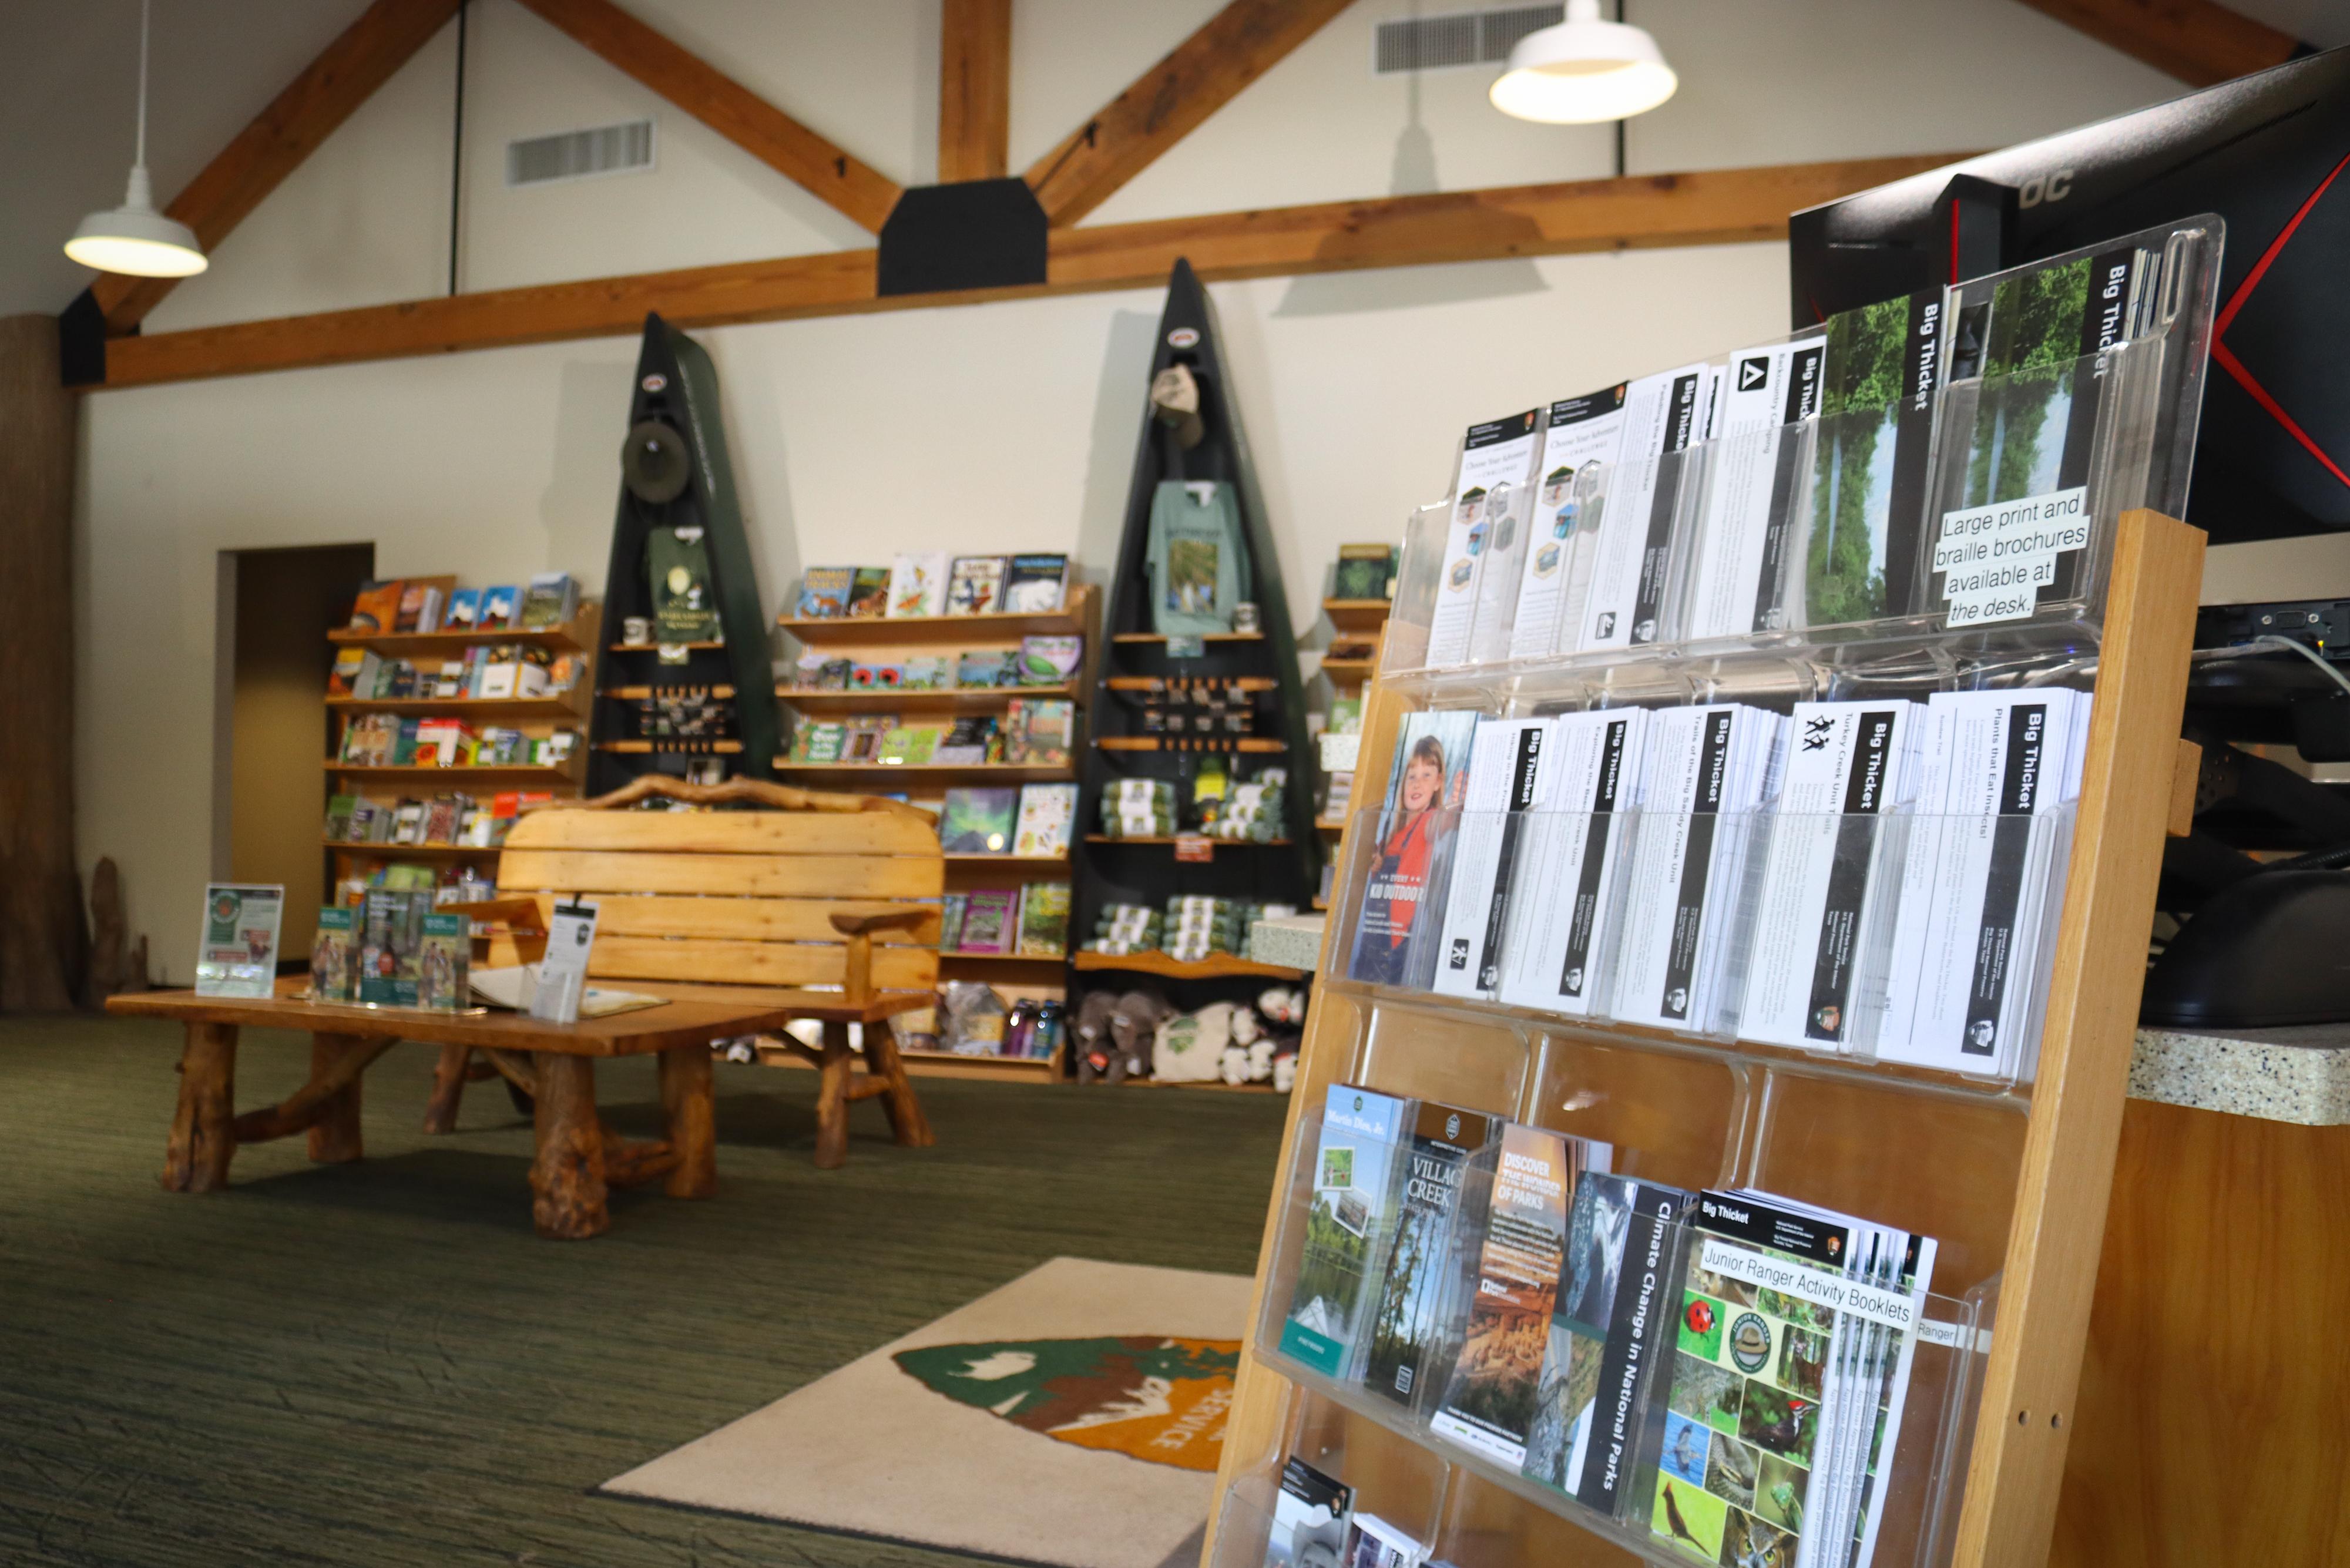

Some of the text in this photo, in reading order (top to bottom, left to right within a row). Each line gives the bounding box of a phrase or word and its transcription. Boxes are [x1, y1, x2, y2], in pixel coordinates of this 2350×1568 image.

[2019, 170, 2074, 209] OC
[2103, 264, 2126, 298] Big
[1801, 356, 1818, 381] Big
[1915, 303, 1938, 411] Big Thicket
[1673, 379, 1696, 455] Big Thicke
[1943, 493, 2080, 538] Large print and
[1936, 526, 2086, 566] braille brochures
[1948, 561, 2052, 593] available at
[1951, 594, 2031, 621] the desk.
[1837, 711, 1853, 747] Turkey
[1506, 733, 1518, 760] Hiking
[1587, 726, 1602, 770] Exploring
[1519, 730, 1542, 804] Big Thicket
[1603, 723, 1625, 800] Big Thicket
[1707, 718, 1730, 803] Big Thicket
[1832, 750, 1847, 780] Creek
[1860, 723, 1887, 809] Big Thicket
[1978, 708, 2003, 839] Plants that Eat Insects!
[2017, 713, 2043, 809] Big Thicket
[1502, 773, 1511, 787] the
[1585, 771, 1593, 786] the
[1668, 714, 1703, 883] Trails of the Big Sandy Creek Unit
[1828, 782, 1840, 805] Unit
[1573, 818, 1584, 845] Creek
[1569, 847, 1579, 866] Unit
[1369, 884, 1384, 899] KID
[1413, 1157, 1463, 1188] VILLAG
[1502, 1169, 1522, 1186] THE
[1504, 1152, 1550, 1178] DISCOVER
[1408, 1178, 1453, 1208] CREEK
[1498, 1185, 1544, 1210] OF PARKS
[1702, 1200, 1748, 1224] Big Thicket
[1704, 1246, 1910, 1324] Junior Ranger Activity Booklets
[1733, 1314, 1770, 1344] JUNIOR RANGER
[1918, 1323, 1955, 1340] Ranger
[1600, 1201, 1673, 1492] Climate Change in National Parks
[1827, 1404, 1835, 1424] versus
[1839, 1404, 1848, 1424] versus
[1824, 1427, 1834, 1445] today
[1836, 1427, 1845, 1445] today
[1820, 1447, 1829, 1471] Thicket
[1832, 1447, 1842, 1471] Thicket
[1819, 1474, 1828, 1484] Big
[1831, 1473, 1839, 1484] Big
[1816, 1487, 1826, 1509] visiting
[1827, 1486, 1838, 1509] visiting
[1812, 1512, 1822, 1538] contrast
[1823, 1512, 1833, 1539] contrast
[1810, 1539, 1818, 1553] and
[1821, 1540, 1829, 1553] and
